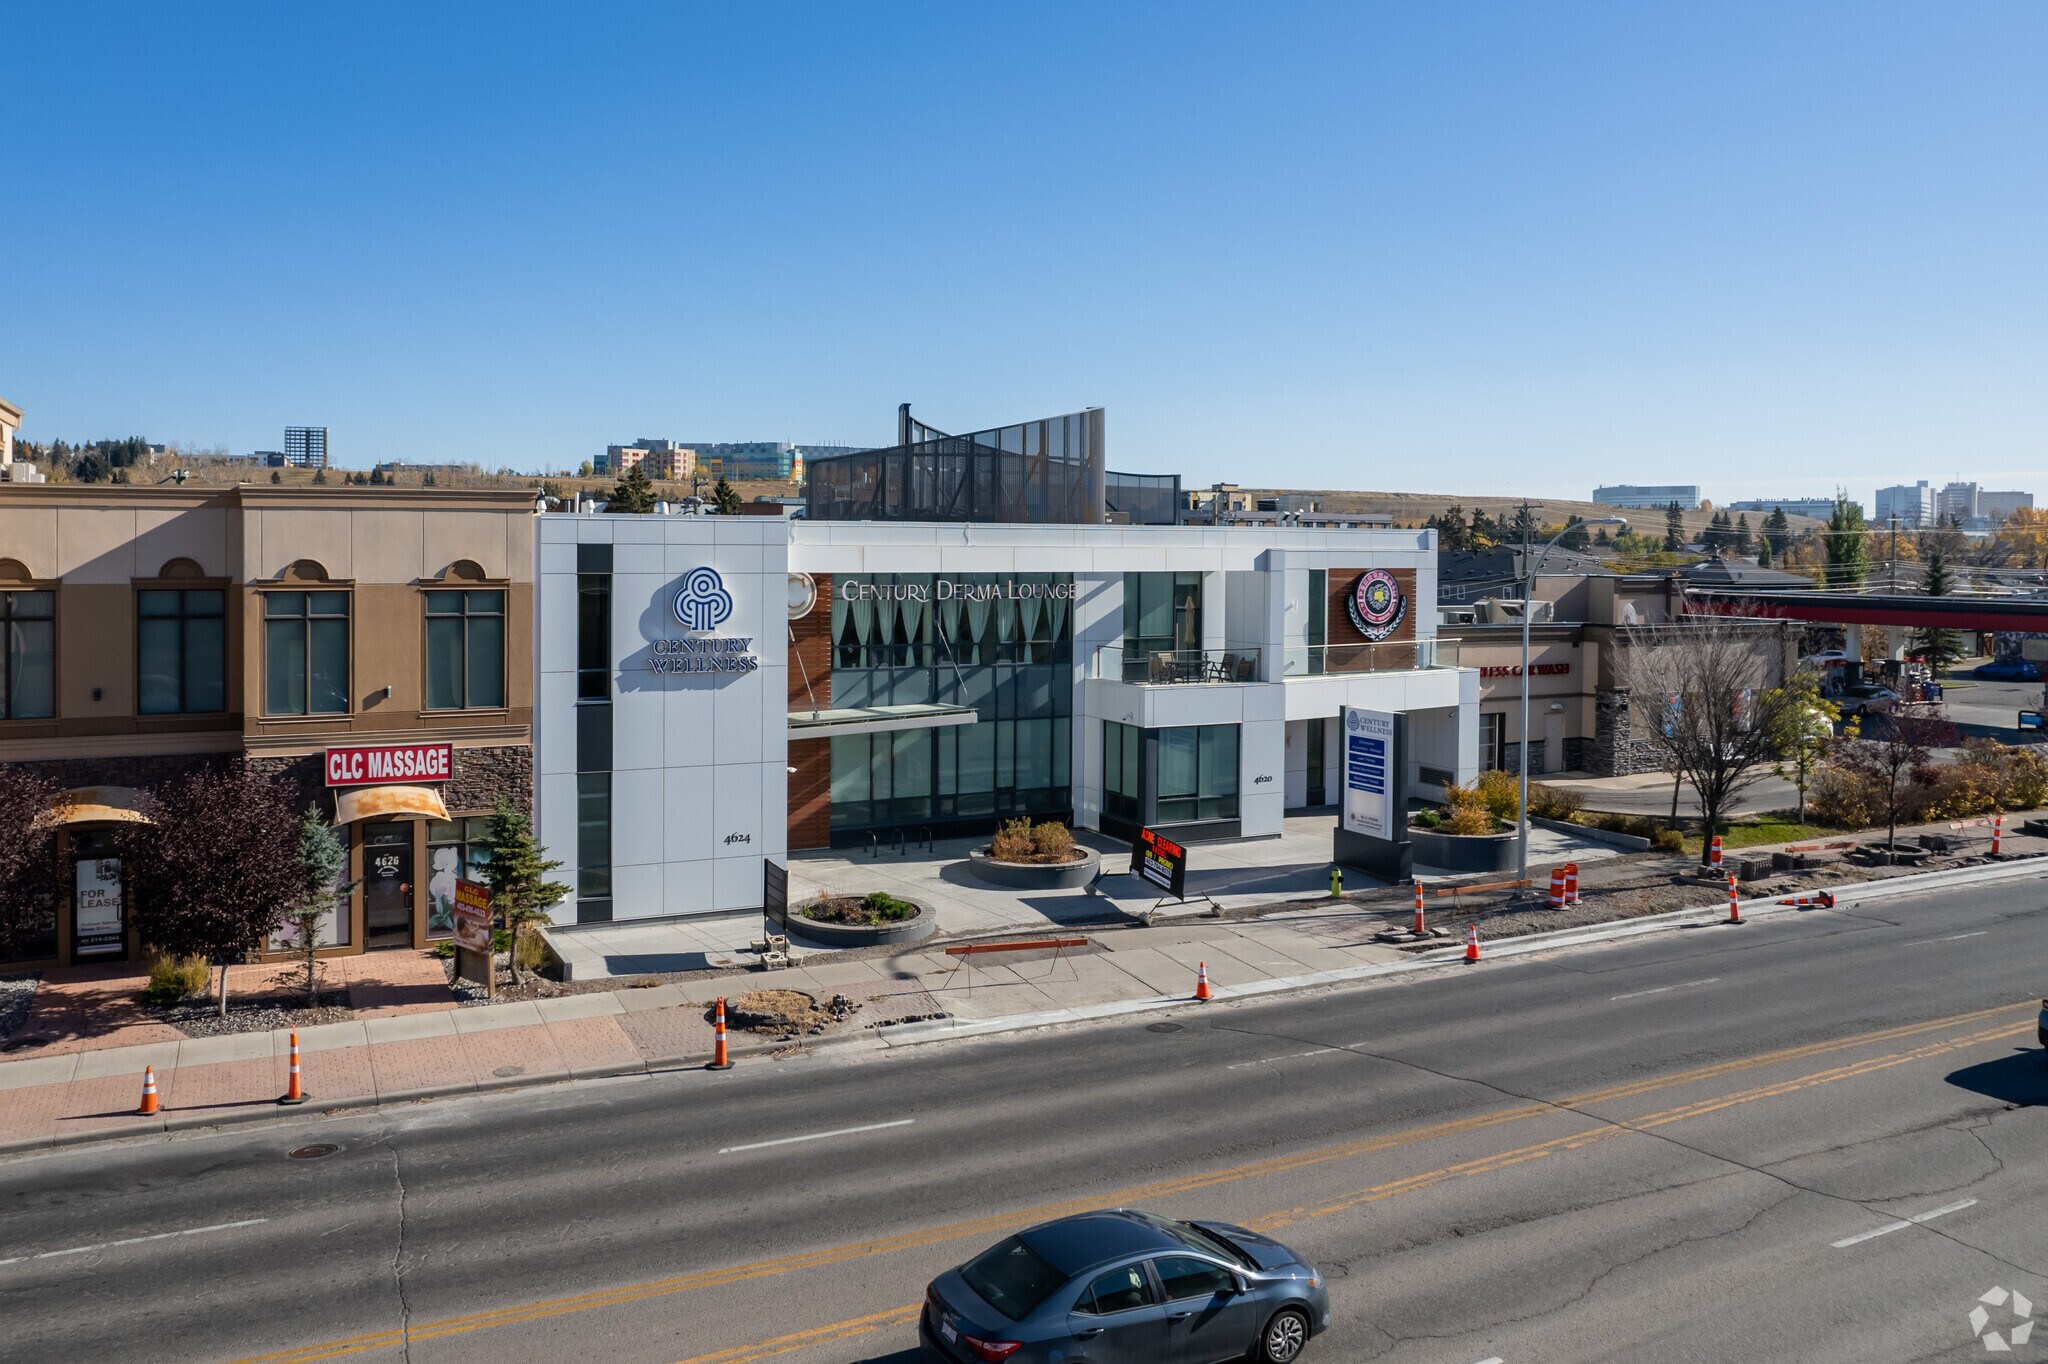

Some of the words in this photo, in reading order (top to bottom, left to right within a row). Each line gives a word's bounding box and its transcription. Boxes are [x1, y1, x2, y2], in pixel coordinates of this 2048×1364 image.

[842, 580, 930, 602] CENTURY
[937, 580, 1001, 602] DERMA
[1008, 580, 1078, 599] LOUNGE
[654, 638, 753, 655] CENTURY
[649, 656, 758, 674] WELLNESS
[1537, 664, 1569, 675] WASH
[1360, 717, 1390, 727] CENTURY
[1360, 725, 1392, 735] WELLNESS
[330, 752, 363, 780] CLC
[368, 749, 448, 778] MASSAGE
[1254, 775, 1272, 785] 4620
[724, 832, 751, 845] 4624
[1141, 828, 1155, 844] ACNE
[1157, 836, 1181, 858] CLEARING
[375, 856, 399, 866] 4626
[1158, 856, 1173, 869] PROMO
[80, 889, 105, 898] FOR
[464, 886, 479, 894] CLC
[80, 898, 119, 908] LEASE
[456, 890, 487, 910] MASSAGE
